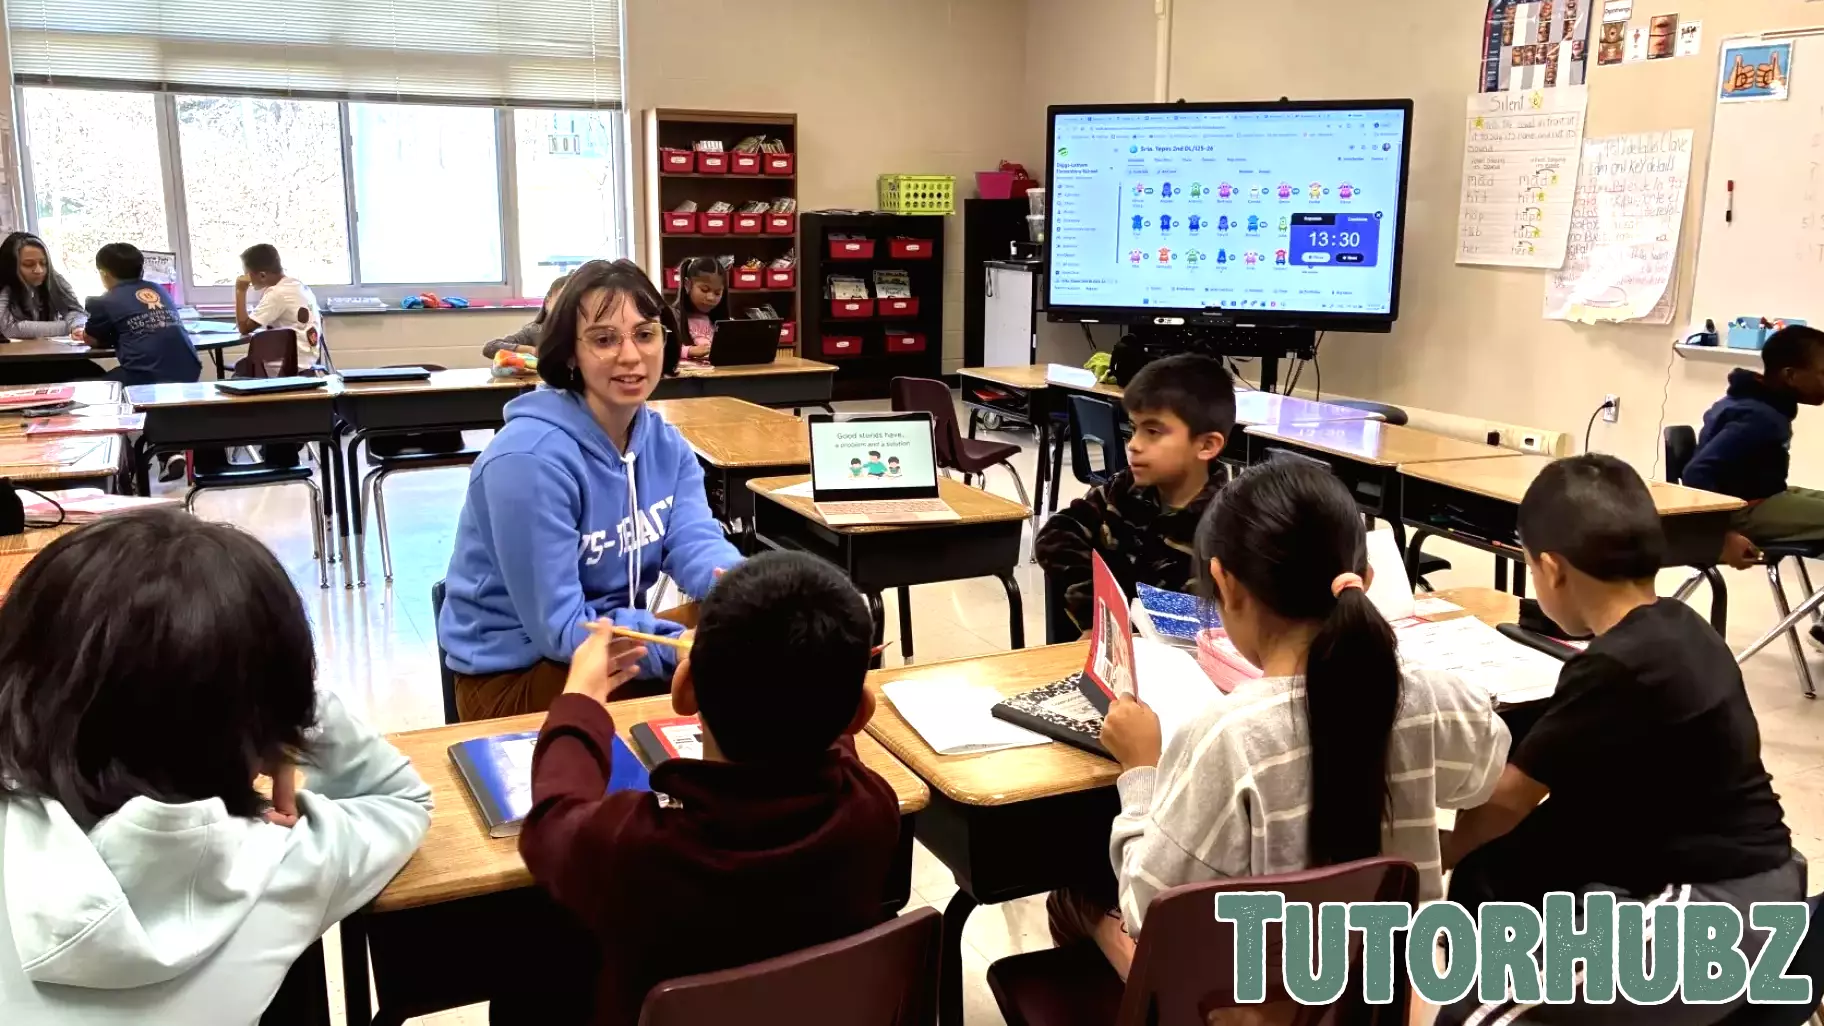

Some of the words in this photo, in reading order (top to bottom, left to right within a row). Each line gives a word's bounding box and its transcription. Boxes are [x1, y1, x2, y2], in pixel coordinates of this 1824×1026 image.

[1490, 94, 1524, 112] Silent
[1547, 116, 1564, 126] front
[1308, 231, 1361, 248] 13:30
[837, 432, 857, 440] Good
